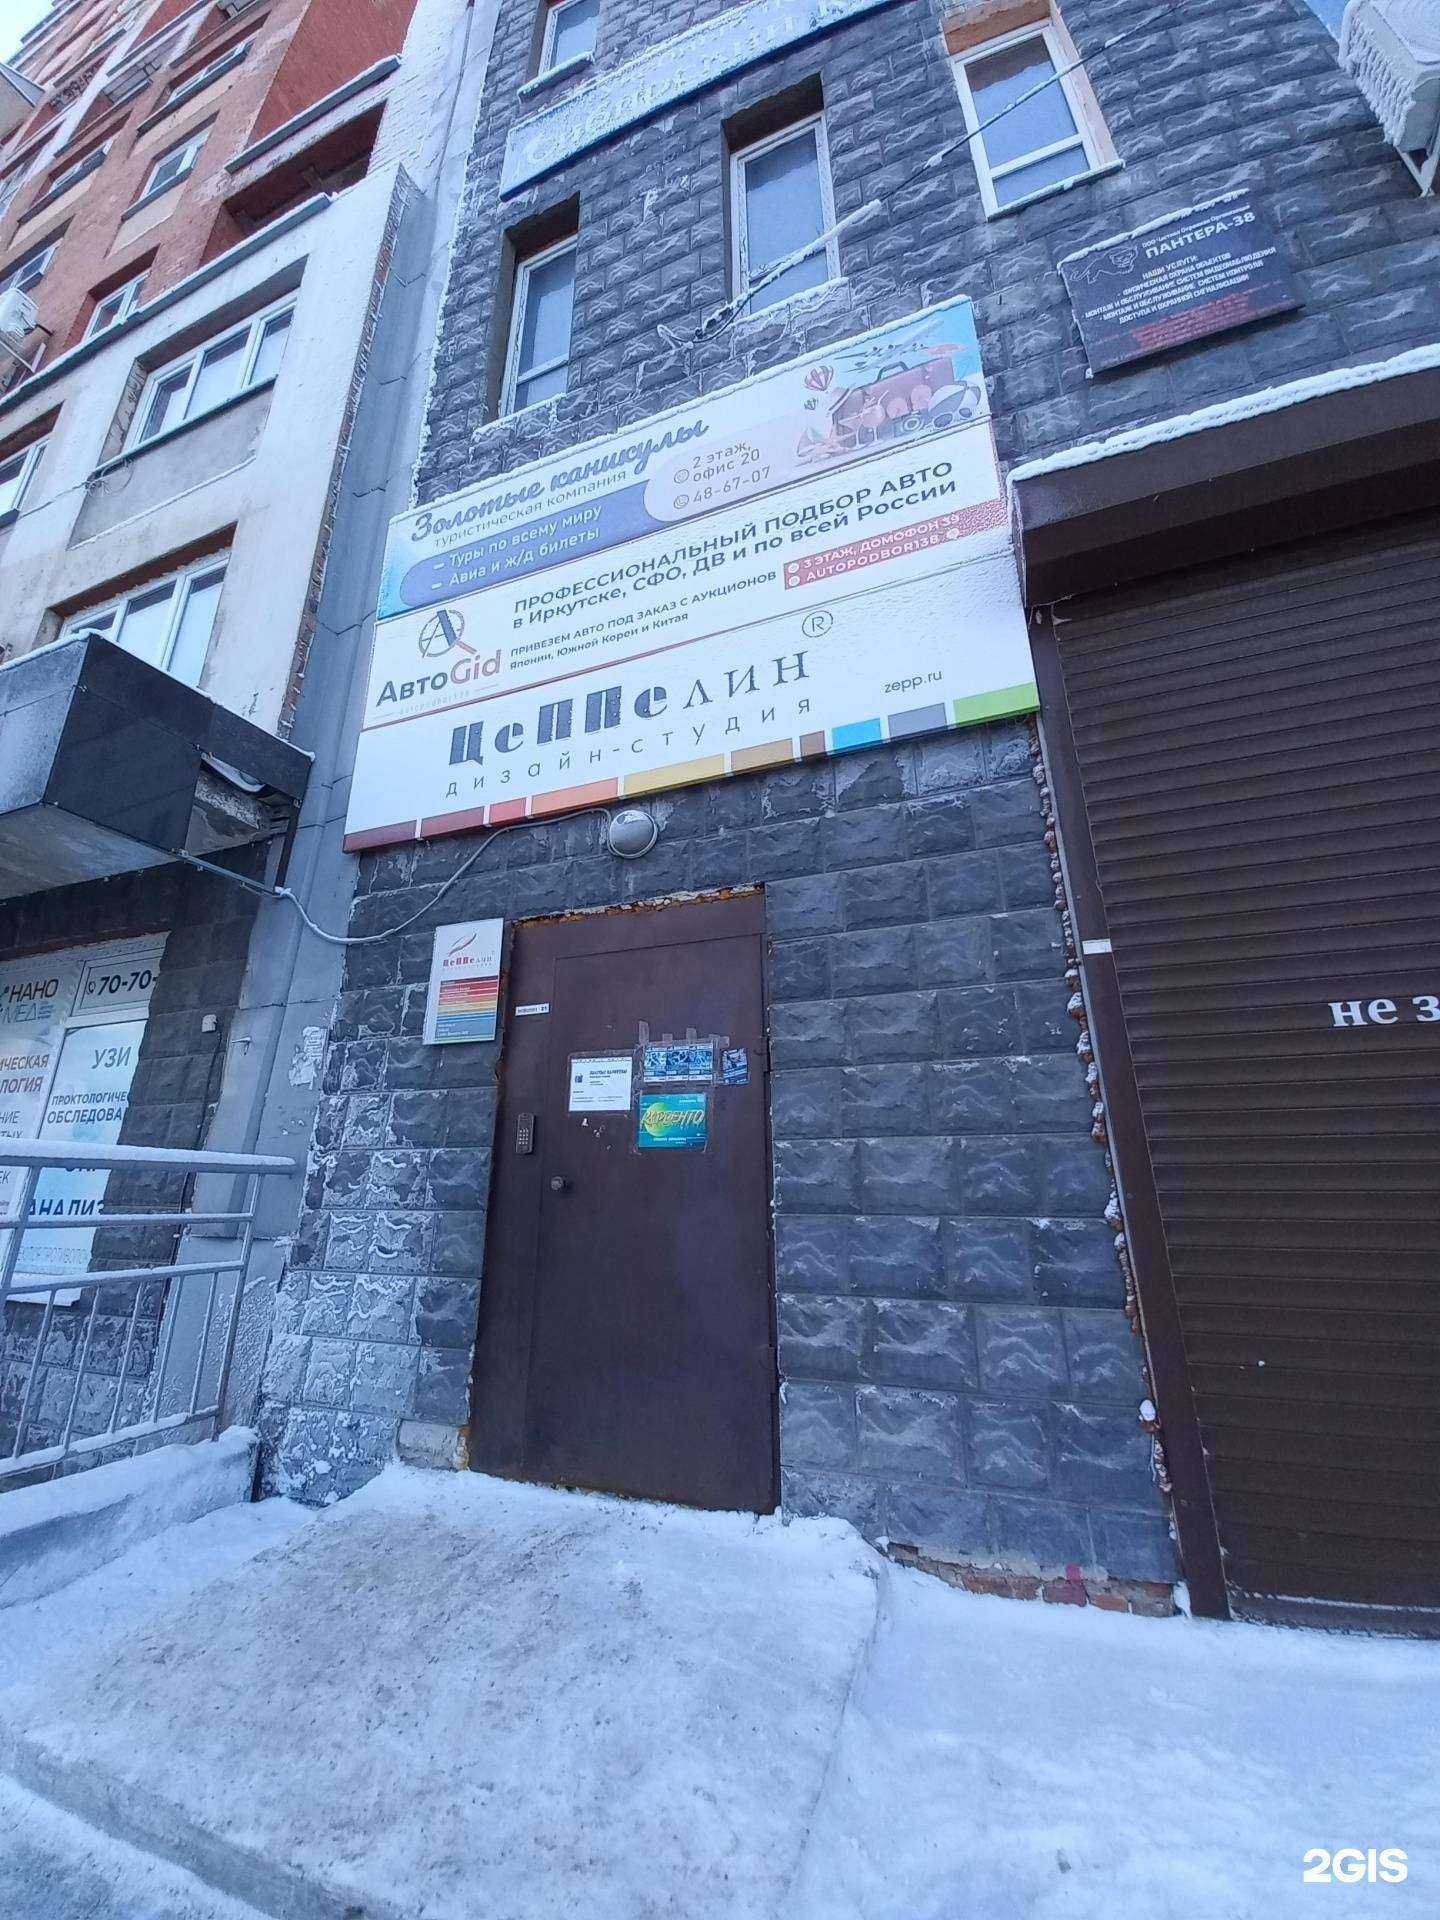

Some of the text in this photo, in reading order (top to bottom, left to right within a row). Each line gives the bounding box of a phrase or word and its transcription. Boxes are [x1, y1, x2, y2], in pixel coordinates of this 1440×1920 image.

[1146, 212, 1256, 259] ПАНТЕРА-38
[692, 441, 752, 469] 2 этаж,
[692, 449, 760, 484] офис 20
[411, 420, 709, 542] Золотые каникулы
[693, 465, 772, 503] 48-67-07
[435, 470, 626, 548] туристическая компания
[448, 504, 603, 569] Туры по всему миру
[449, 527, 599, 587] Авиа и ж/д билеты
[513, 480, 956, 629] в Иркутске, СФО, ДВ и по всей России
[514, 462, 952, 614] ПРОФЕССИОНАЛЬНЫЙ ПОДБОР АВТО
[803, 559, 812, 569] 3
[860, 523, 939, 554] ДОМОФОН
[806, 535, 939, 582] AUTOPODBOR138
[510, 631, 571, 657] ПРИВЕЗЕМ
[572, 621, 605, 639] АВТО
[608, 614, 634, 630] ПОД
[637, 601, 677, 621] ЗАКАЗ
[691, 571, 777, 604] АУКЦИОНОВ
[510, 651, 554, 671] Японии,
[557, 637, 599, 657] Южной
[602, 627, 639, 645] Кореи
[652, 611, 689, 630] Китая
[884, 670, 942, 694] zepp.ru
[8, 979, 59, 1003] НАНО
[1328, 998, 1399, 1027] не
[92, 1046, 131, 1069] УЗИ
